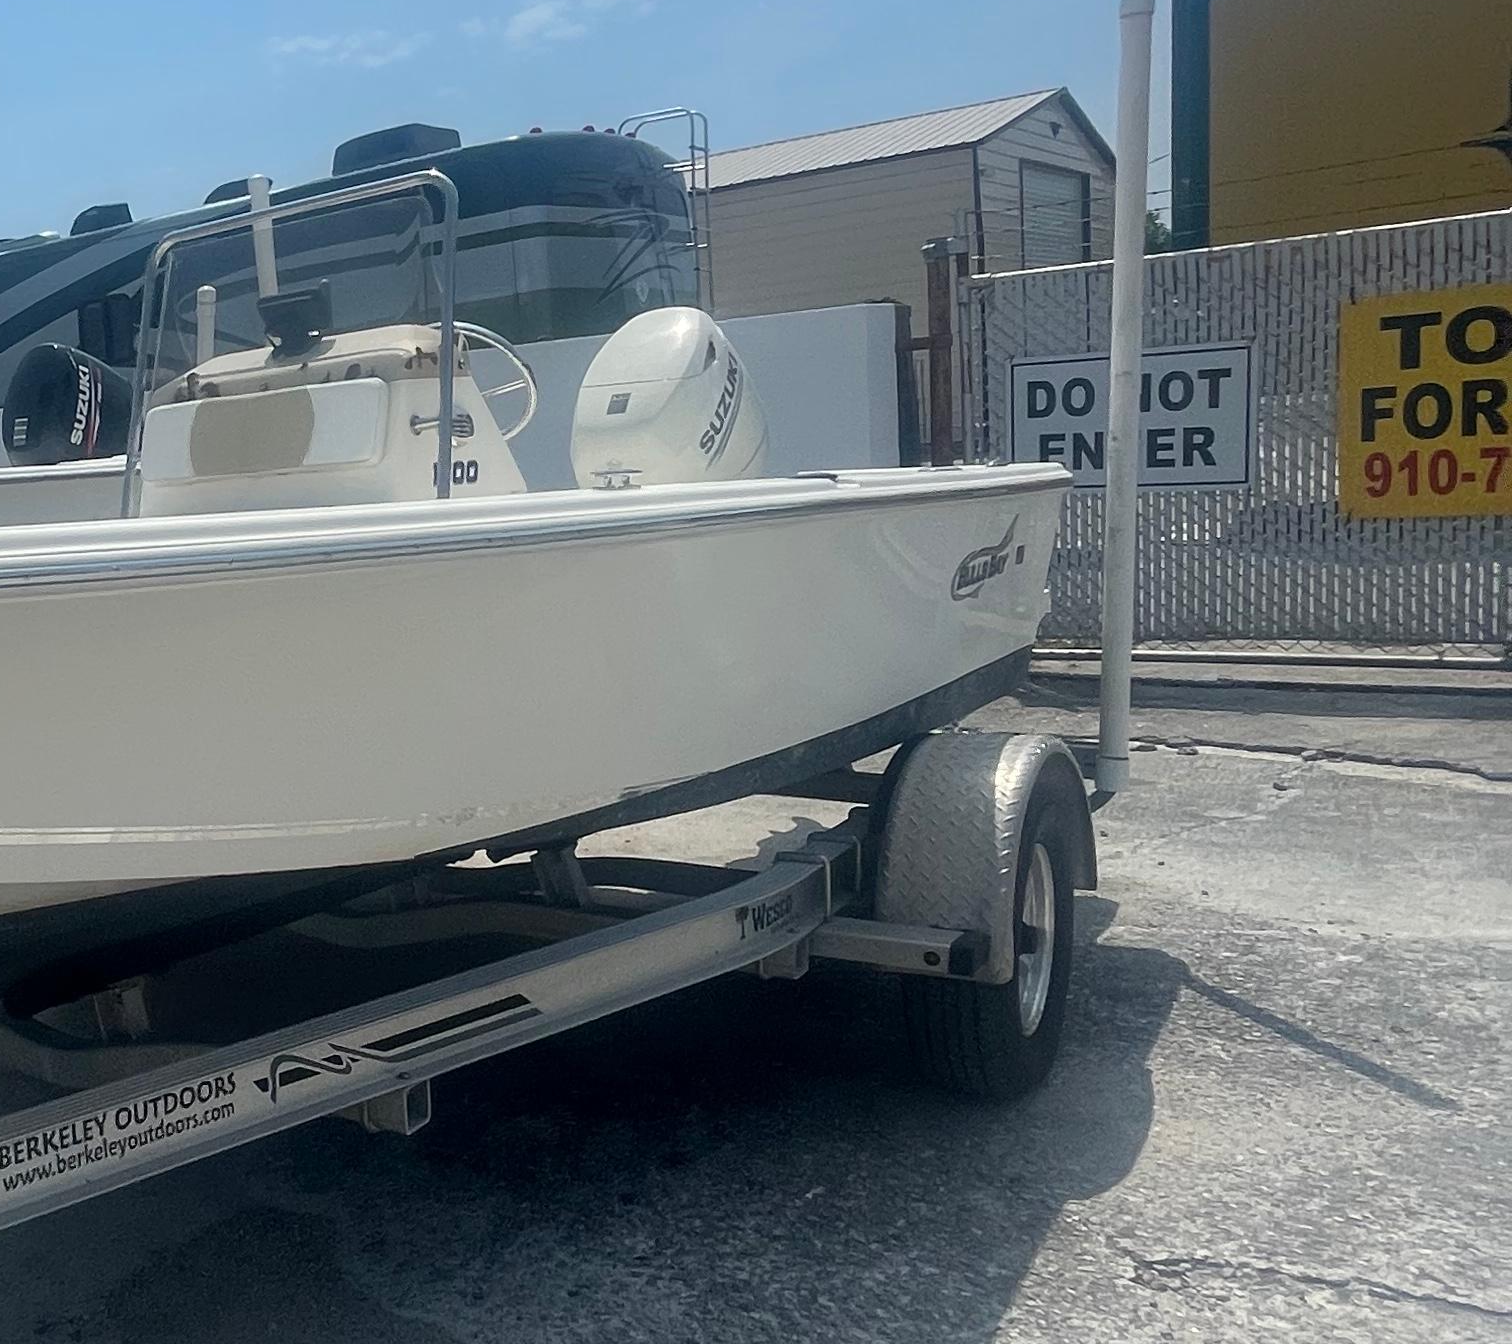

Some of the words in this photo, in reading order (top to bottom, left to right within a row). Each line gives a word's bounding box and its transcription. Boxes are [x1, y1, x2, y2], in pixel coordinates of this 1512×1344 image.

[70, 364, 90, 446] SUZUKI
[699, 352, 738, 455] SUZUKI
[1027, 377, 1096, 419] DO
[1361, 378, 1510, 443] FOR
[1039, 426, 1217, 471] ENER
[1364, 447, 1511, 498] 910-7
[115, 1072, 236, 1130] OUTDOORS
[2, 1101, 235, 1192] www.berkeleyoutdoors.com
